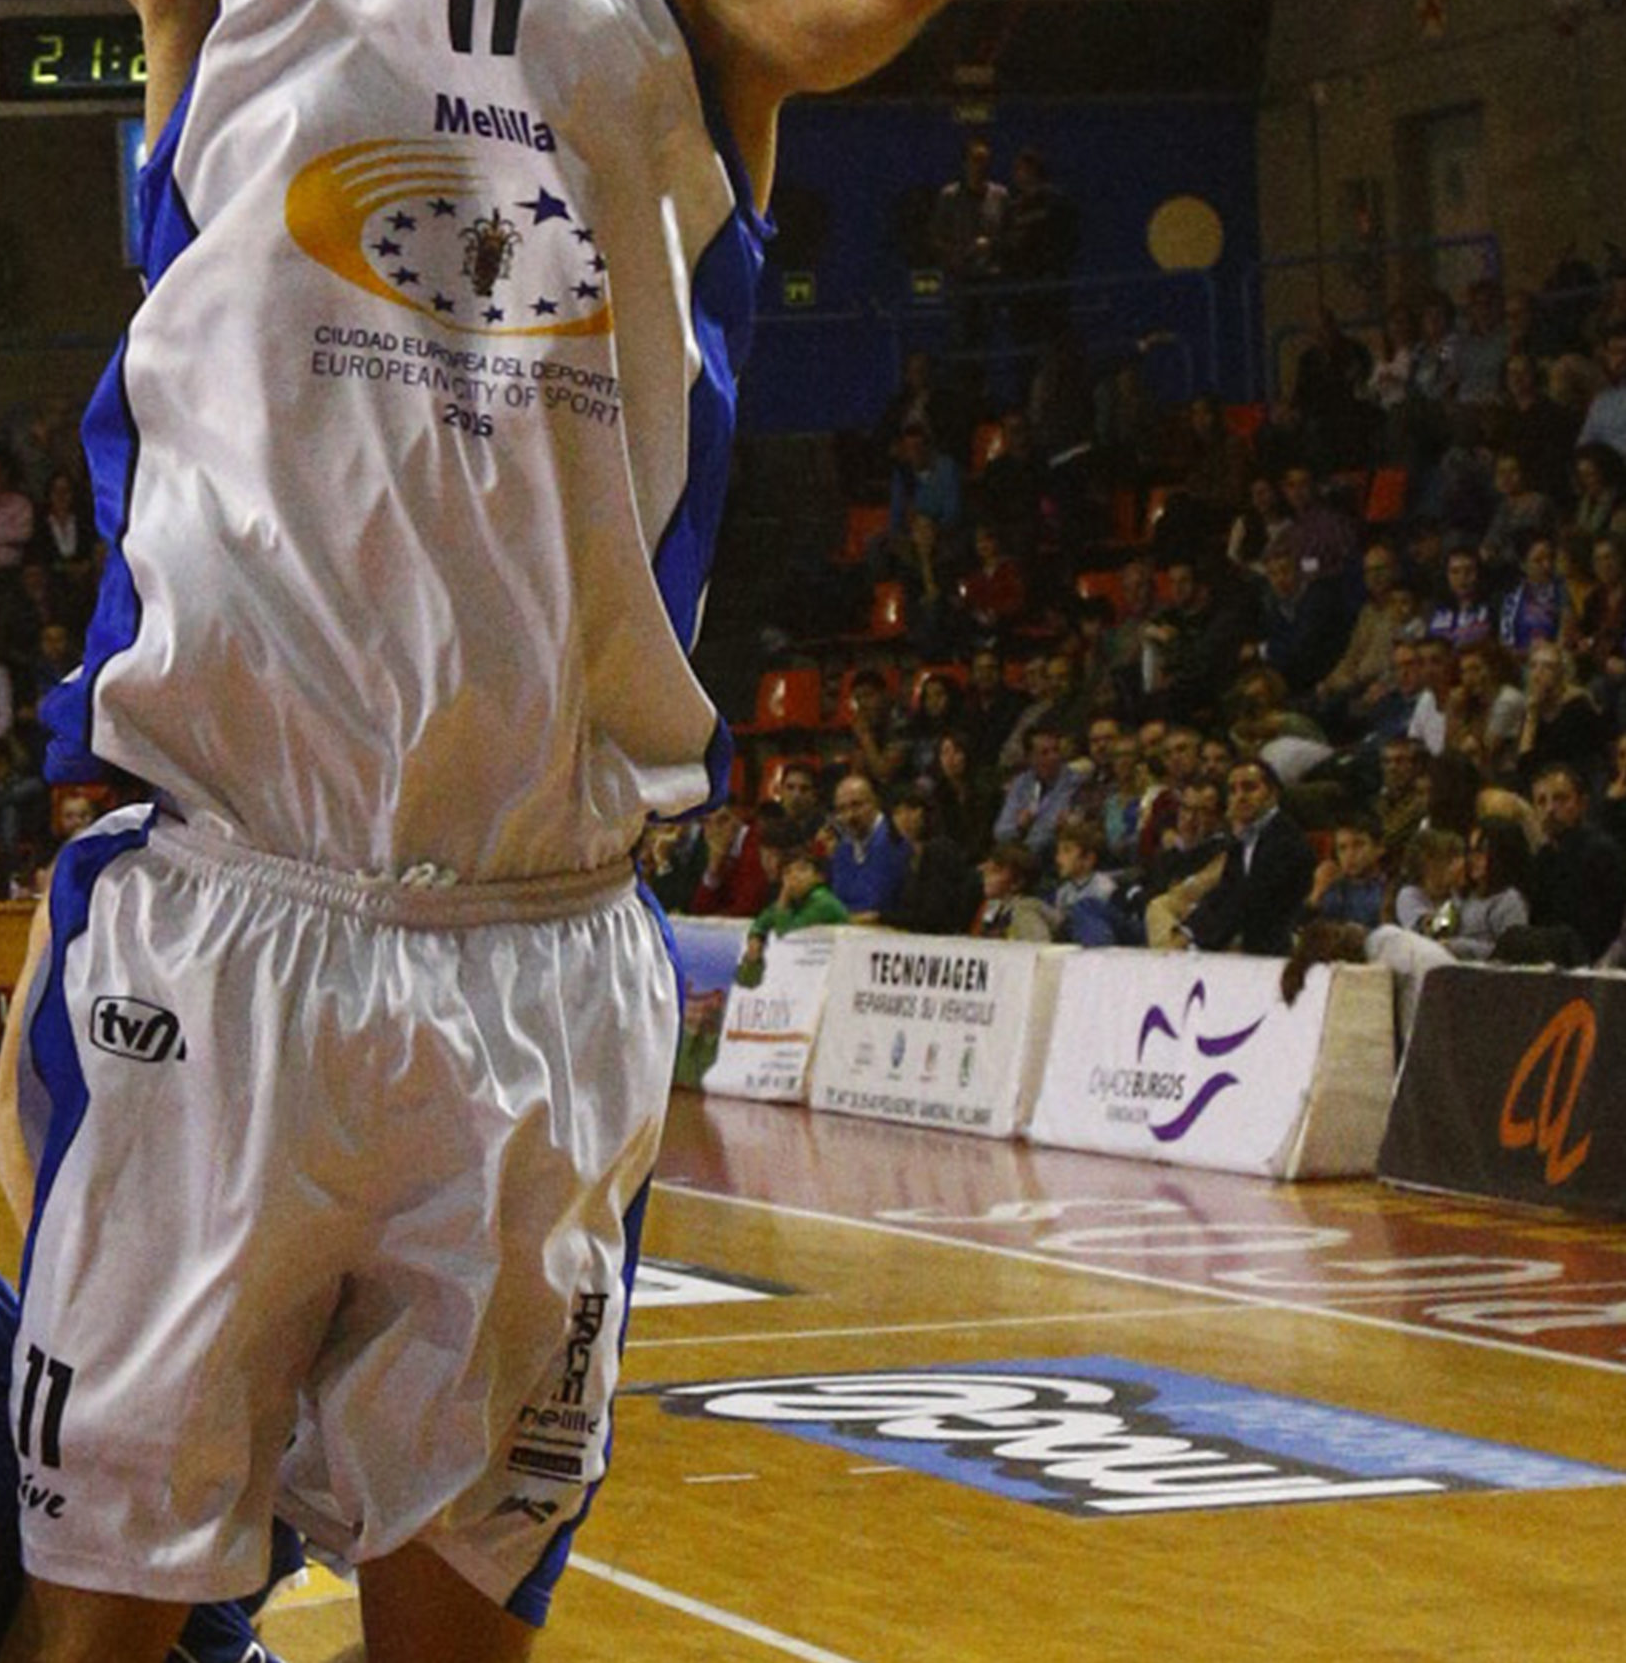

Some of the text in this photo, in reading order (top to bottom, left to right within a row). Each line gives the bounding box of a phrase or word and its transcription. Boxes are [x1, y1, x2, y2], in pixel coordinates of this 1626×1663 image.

[433, 93, 557, 153] Melilla
[314, 325, 398, 354] CIUDAD
[492, 356, 525, 379] DEL
[310, 351, 449, 391] EUROPEAN
[504, 383, 538, 409] OF
[544, 384, 621, 429] SPORT
[871, 951, 989, 992] TECNOWAGEN
[18, 1342, 74, 1470] 11
